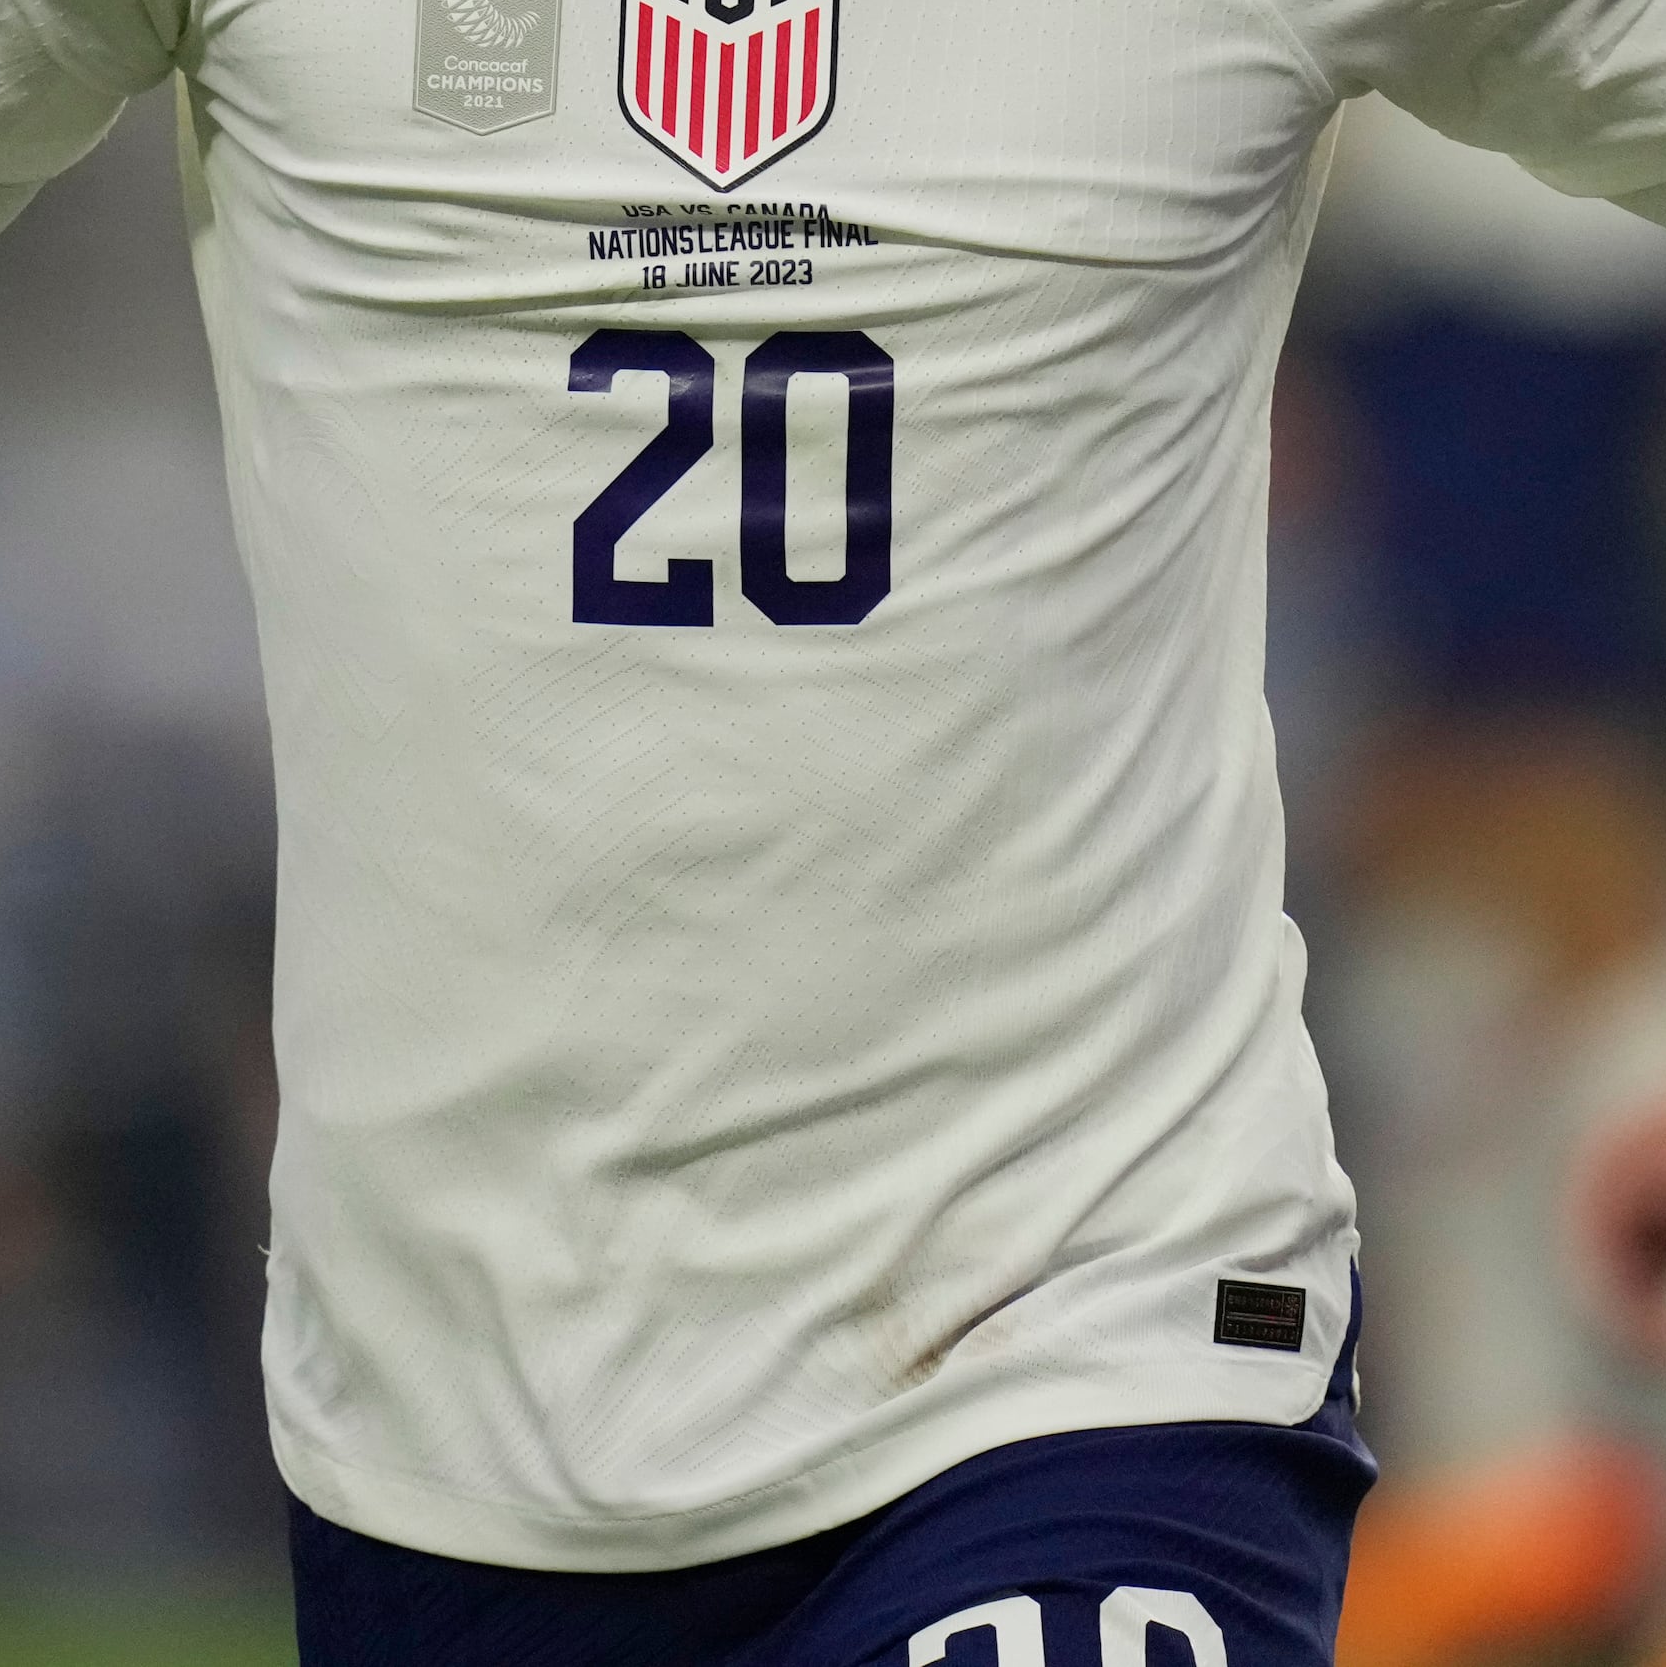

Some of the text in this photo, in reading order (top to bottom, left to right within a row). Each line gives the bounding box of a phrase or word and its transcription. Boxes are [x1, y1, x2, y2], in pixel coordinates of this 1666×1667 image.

[444, 55, 528, 73] Concacaf
[427, 75, 544, 93] CHAMPIONS
[463, 94, 504, 109] 2021
[621, 204, 673, 218] USA
[589, 218, 879, 260] NATIONS LEAGUE FINAL
[642, 259, 813, 290] 18 JUNE 2023
[567, 328, 895, 627] 20
